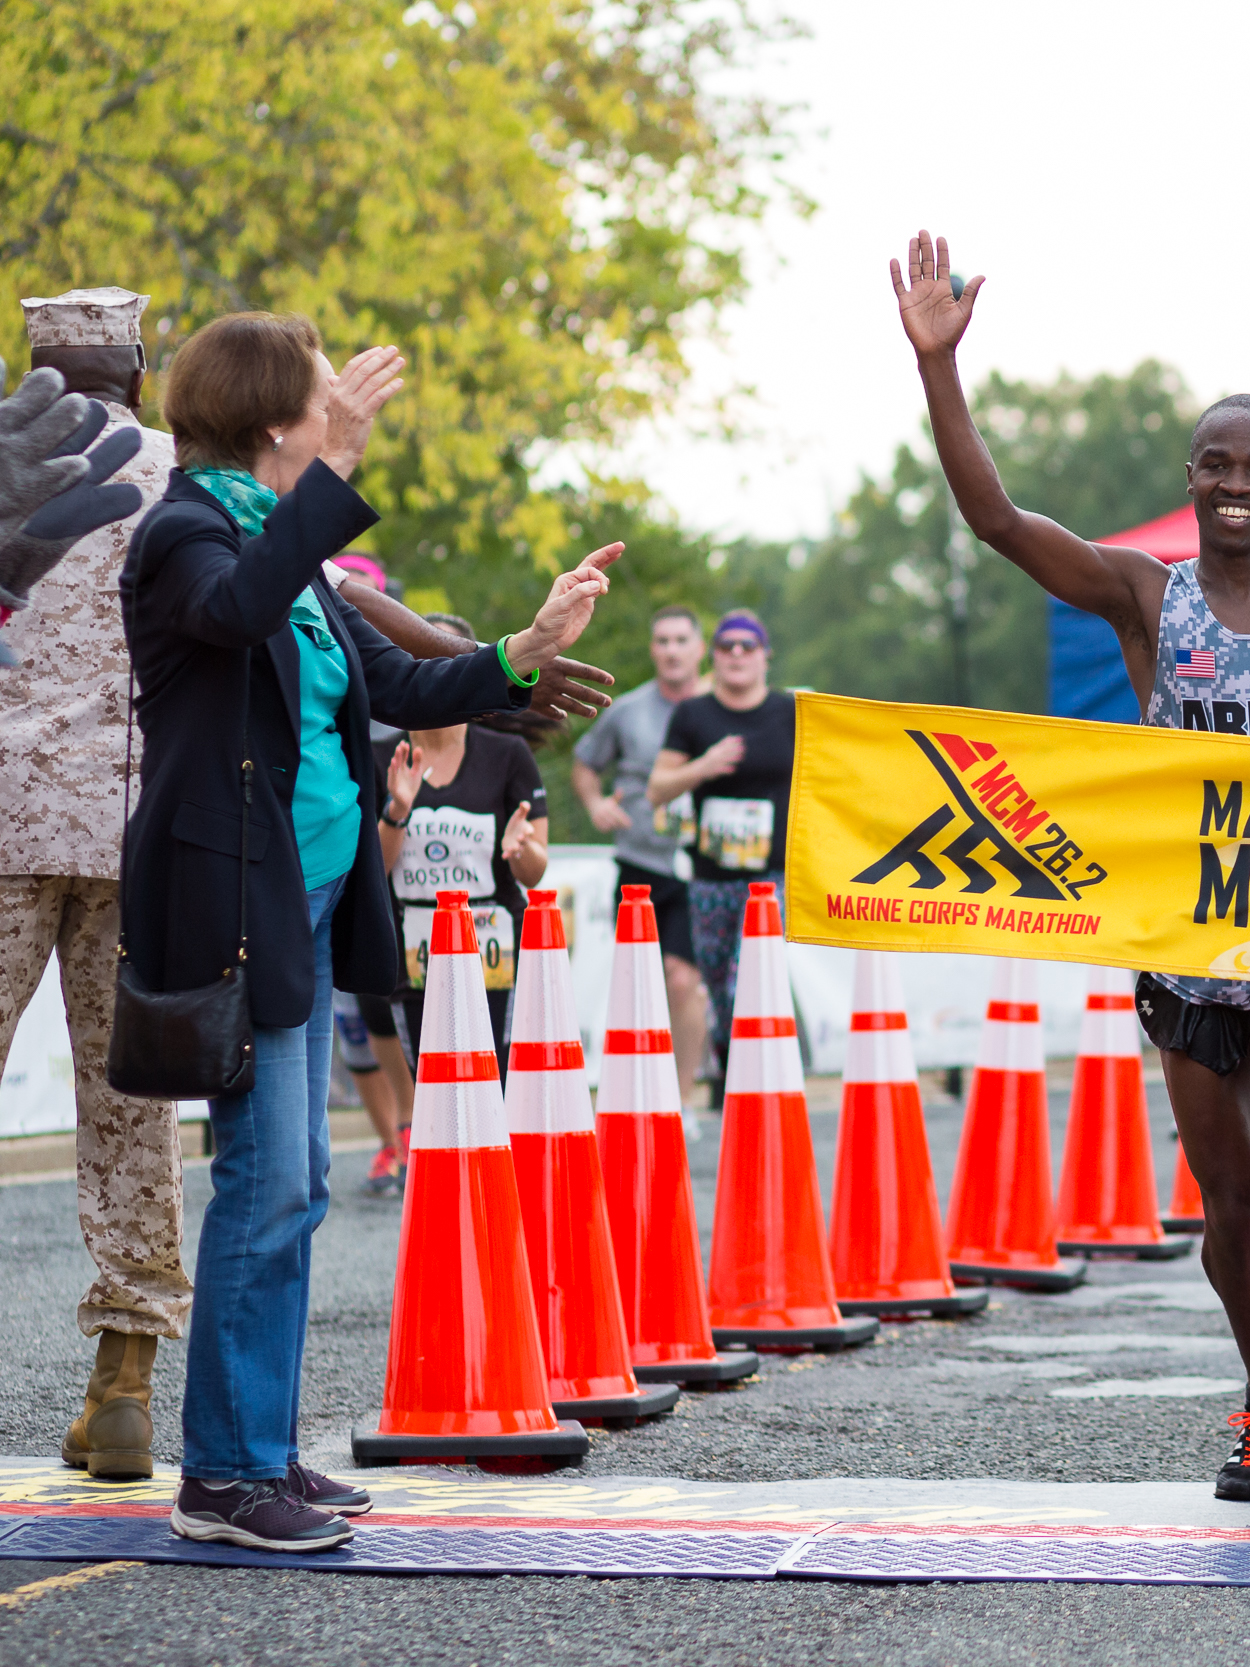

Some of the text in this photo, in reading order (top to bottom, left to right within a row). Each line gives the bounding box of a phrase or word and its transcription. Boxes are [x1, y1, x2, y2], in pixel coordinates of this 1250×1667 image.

[970, 760, 1108, 901] MCM 26.2
[403, 866, 478, 887] BOSTON
[827, 894, 1101, 935] MARINE CORPS MARATHON
